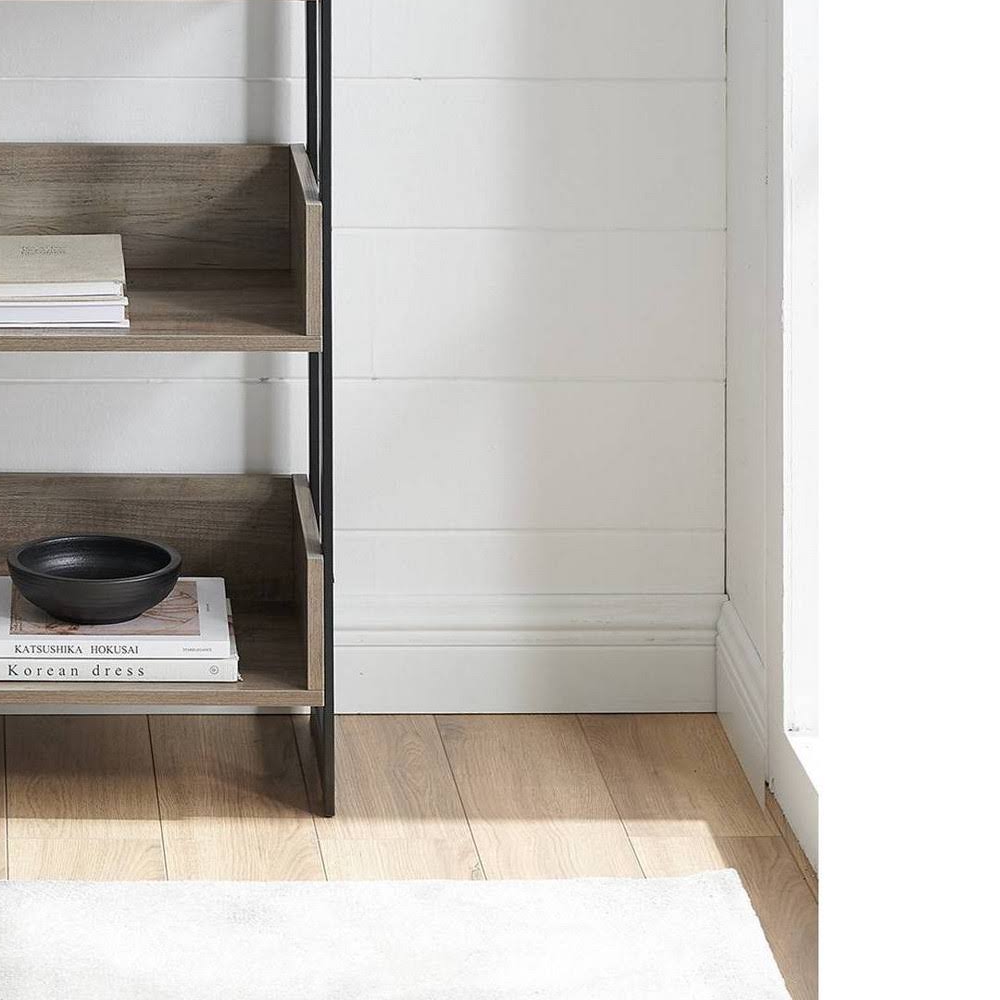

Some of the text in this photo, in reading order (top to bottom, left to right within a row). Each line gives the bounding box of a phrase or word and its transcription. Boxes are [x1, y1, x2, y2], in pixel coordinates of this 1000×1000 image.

[14, 645, 139, 655] KATSUSHIKA HOKUSAI
[8, 664, 145, 677] Korean dress
